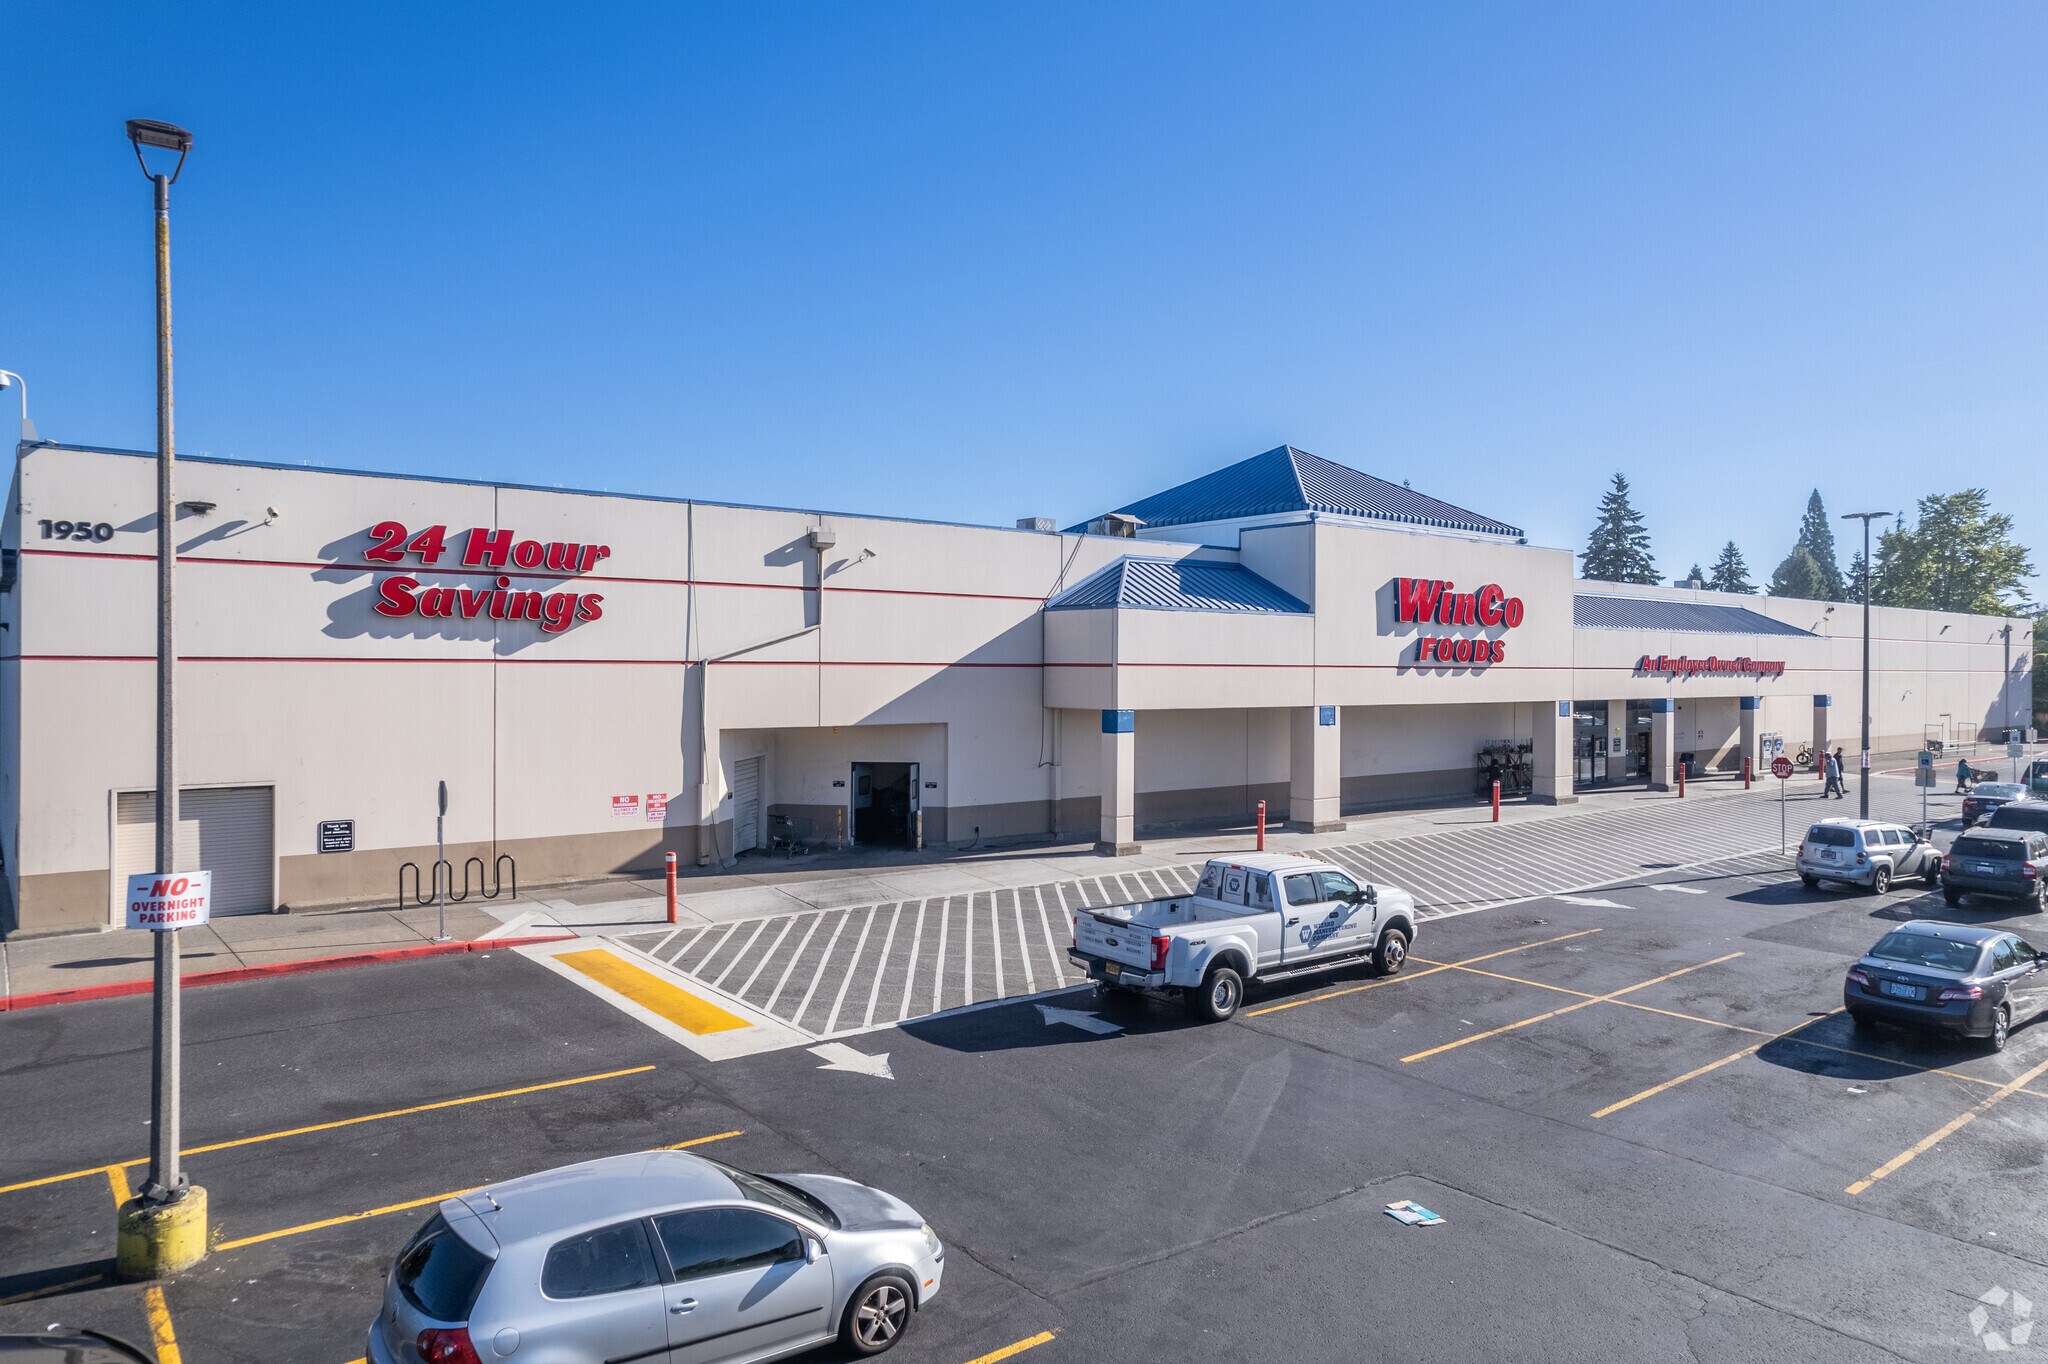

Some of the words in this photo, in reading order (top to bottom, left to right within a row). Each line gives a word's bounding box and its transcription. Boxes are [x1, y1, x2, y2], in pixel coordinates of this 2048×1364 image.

[38, 519, 114, 542] 1950
[364, 520, 447, 564] 24
[462, 527, 611, 572] Hour
[373, 575, 605, 633] Savings
[1393, 577, 1524, 628] WinCo
[1415, 637, 1506, 663] FOODS
[1641, 655, 1659, 671] An
[1660, 655, 1709, 676] Employee
[1709, 656, 1743, 671] Owned
[1743, 656, 1785, 676] Company
[1772, 763, 1793, 773] STOP
[131, 897, 205, 912] OVERNIGHT
[139, 909, 197, 924] PARKING
[1313, 920, 1335, 929] WIZARD
[1312, 932, 1340, 942] COMPANY
[1313, 922, 1358, 936] MANUFACTURING
